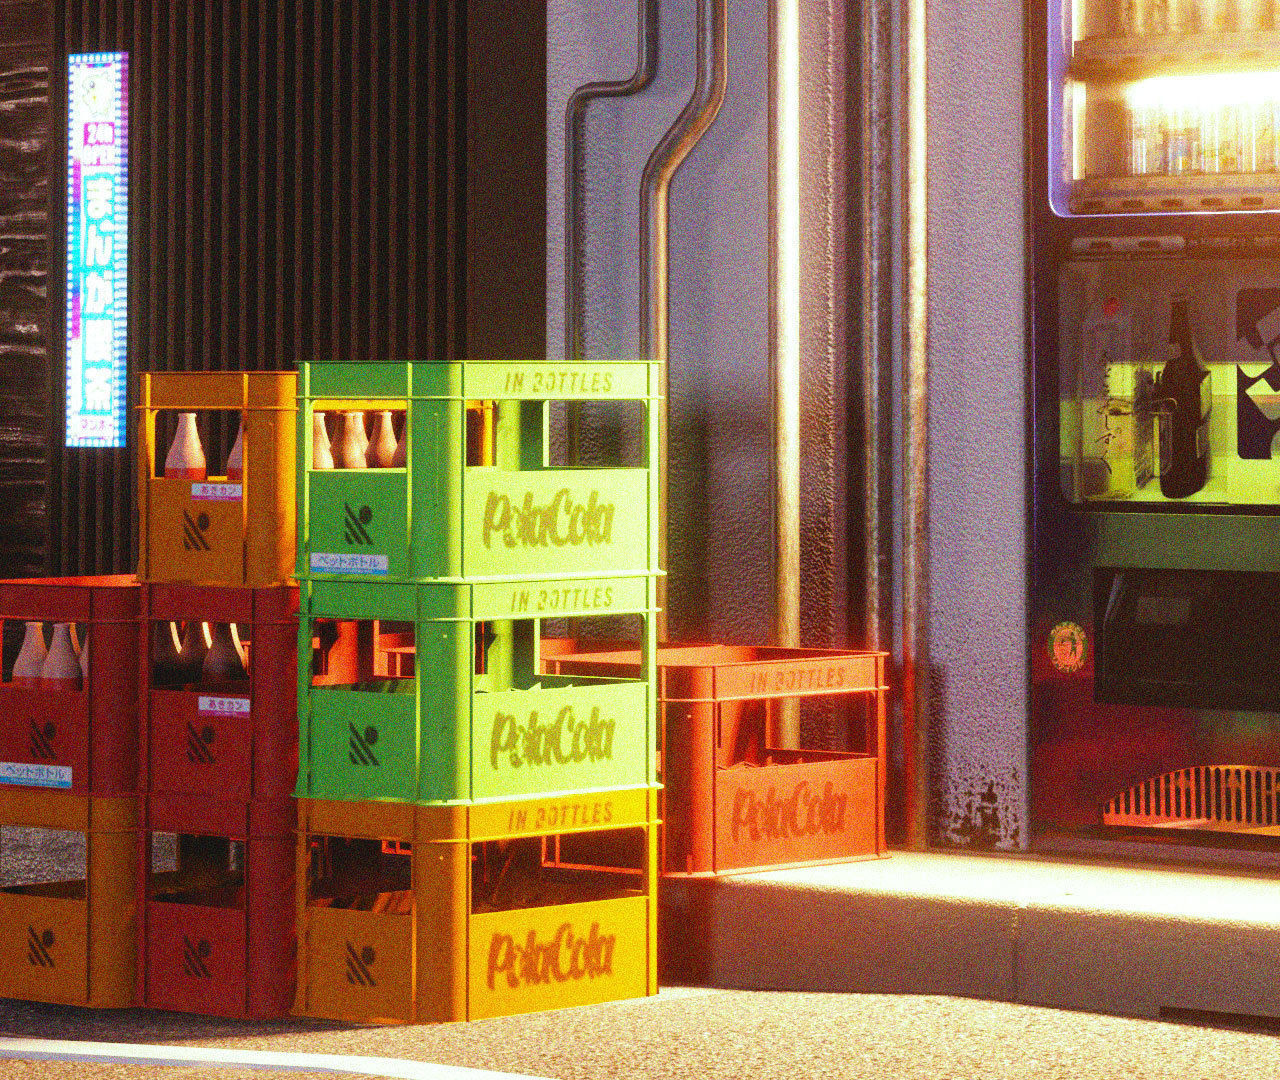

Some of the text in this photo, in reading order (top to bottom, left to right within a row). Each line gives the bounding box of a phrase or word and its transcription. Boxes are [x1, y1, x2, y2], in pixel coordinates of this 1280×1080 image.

[503, 372, 525, 394] IN
[317, 555, 380, 568] ペットボトル
[510, 589, 530, 612] IN
[749, 671, 769, 693] IN
[5, 764, 65, 779] ペットボトル
[508, 808, 528, 831] IN
